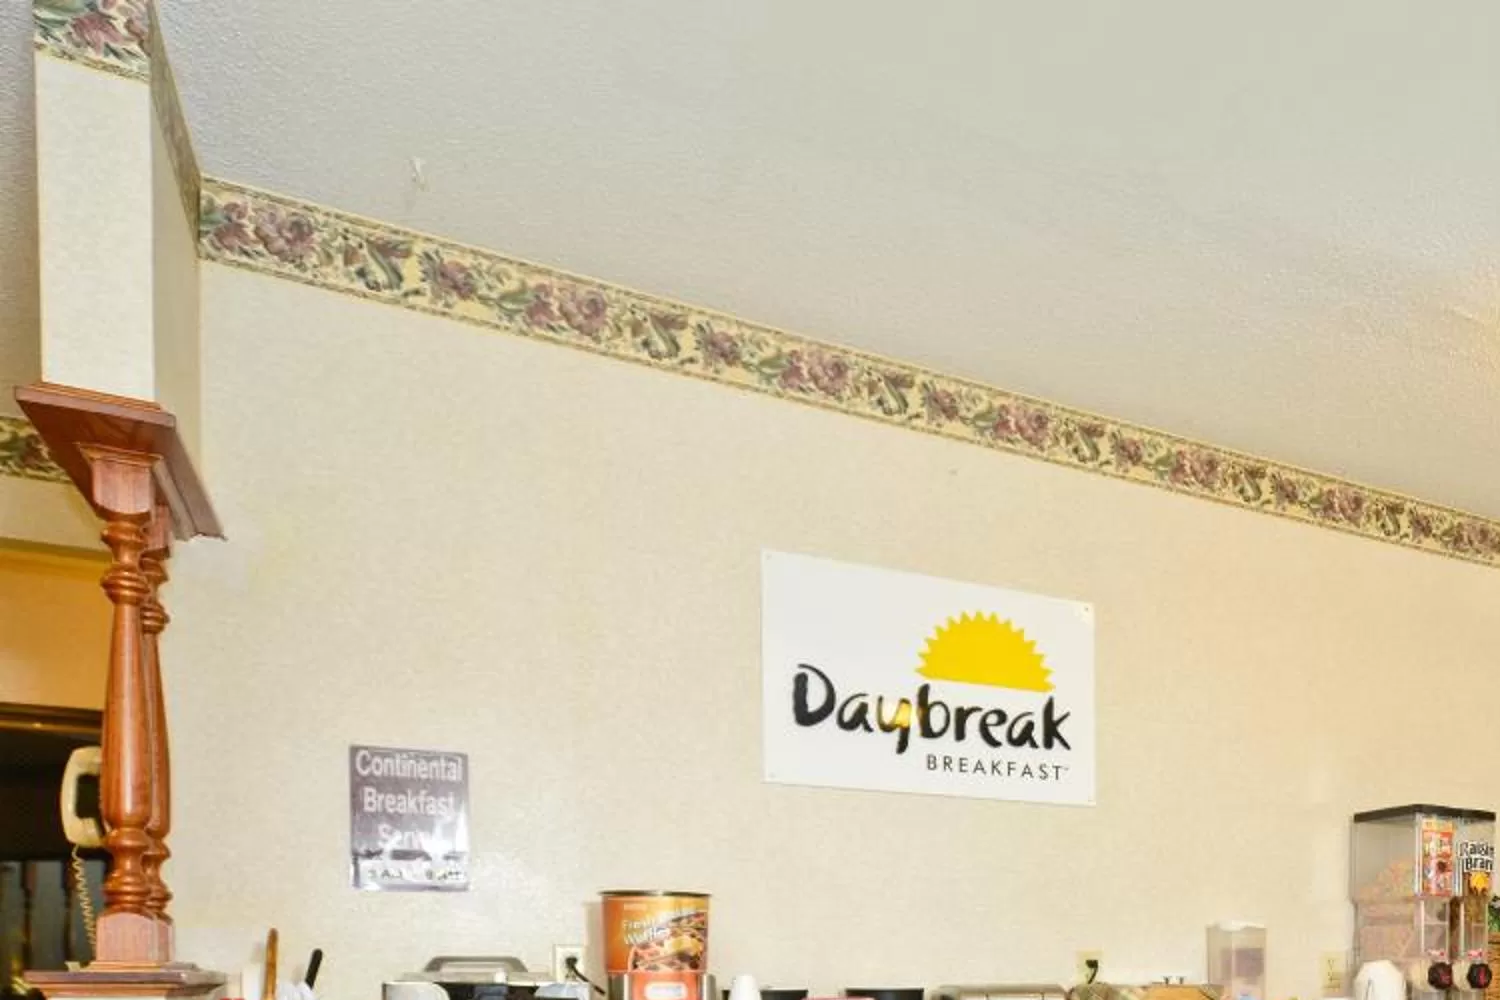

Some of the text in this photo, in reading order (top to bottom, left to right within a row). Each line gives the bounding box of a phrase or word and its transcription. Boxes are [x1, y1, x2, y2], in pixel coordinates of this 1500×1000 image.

[791, 662, 1072, 755] Daybreak
[355, 749, 463, 781] Continental
[925, 753, 1065, 782] BREAKFAST
[362, 786, 455, 818] Breakfast
